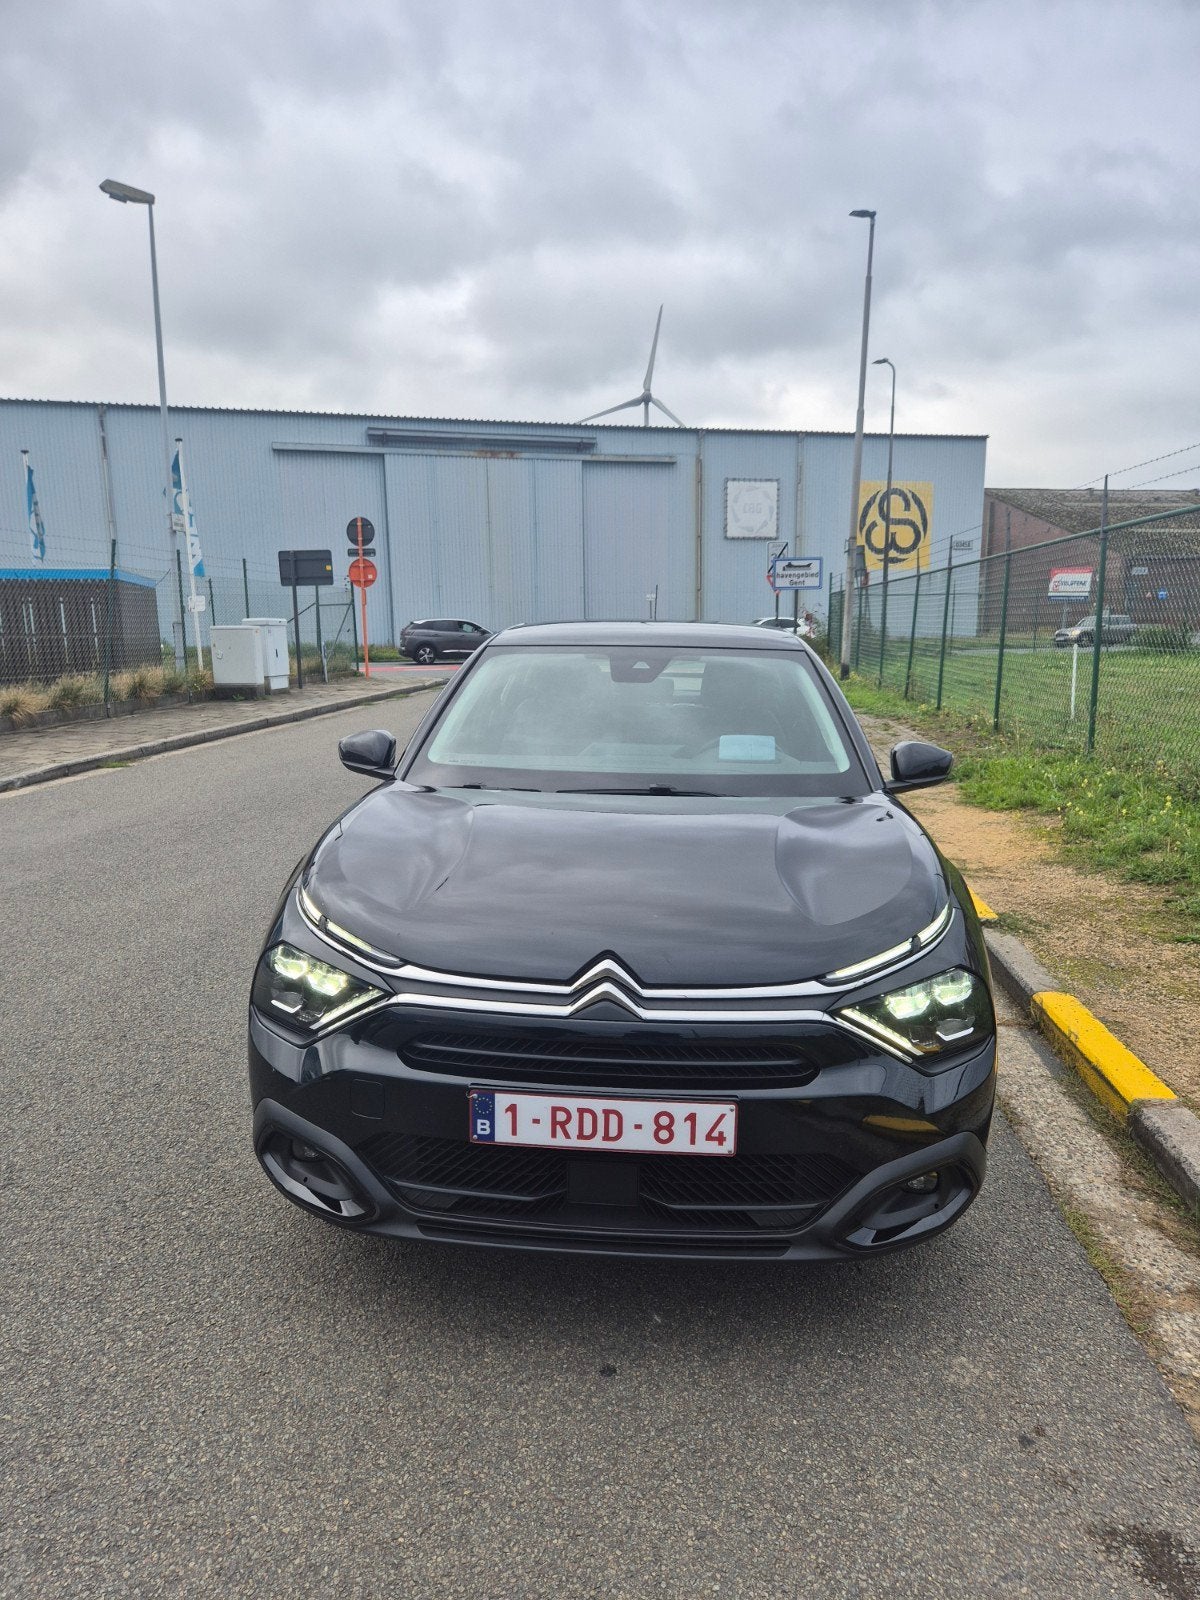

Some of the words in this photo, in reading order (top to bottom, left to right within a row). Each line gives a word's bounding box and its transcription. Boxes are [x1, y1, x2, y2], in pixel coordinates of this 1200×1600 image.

[776, 571, 819, 580] havengebied
[476, 1119, 491, 1135] B
[504, 1103, 727, 1147] 1-RDD-814
